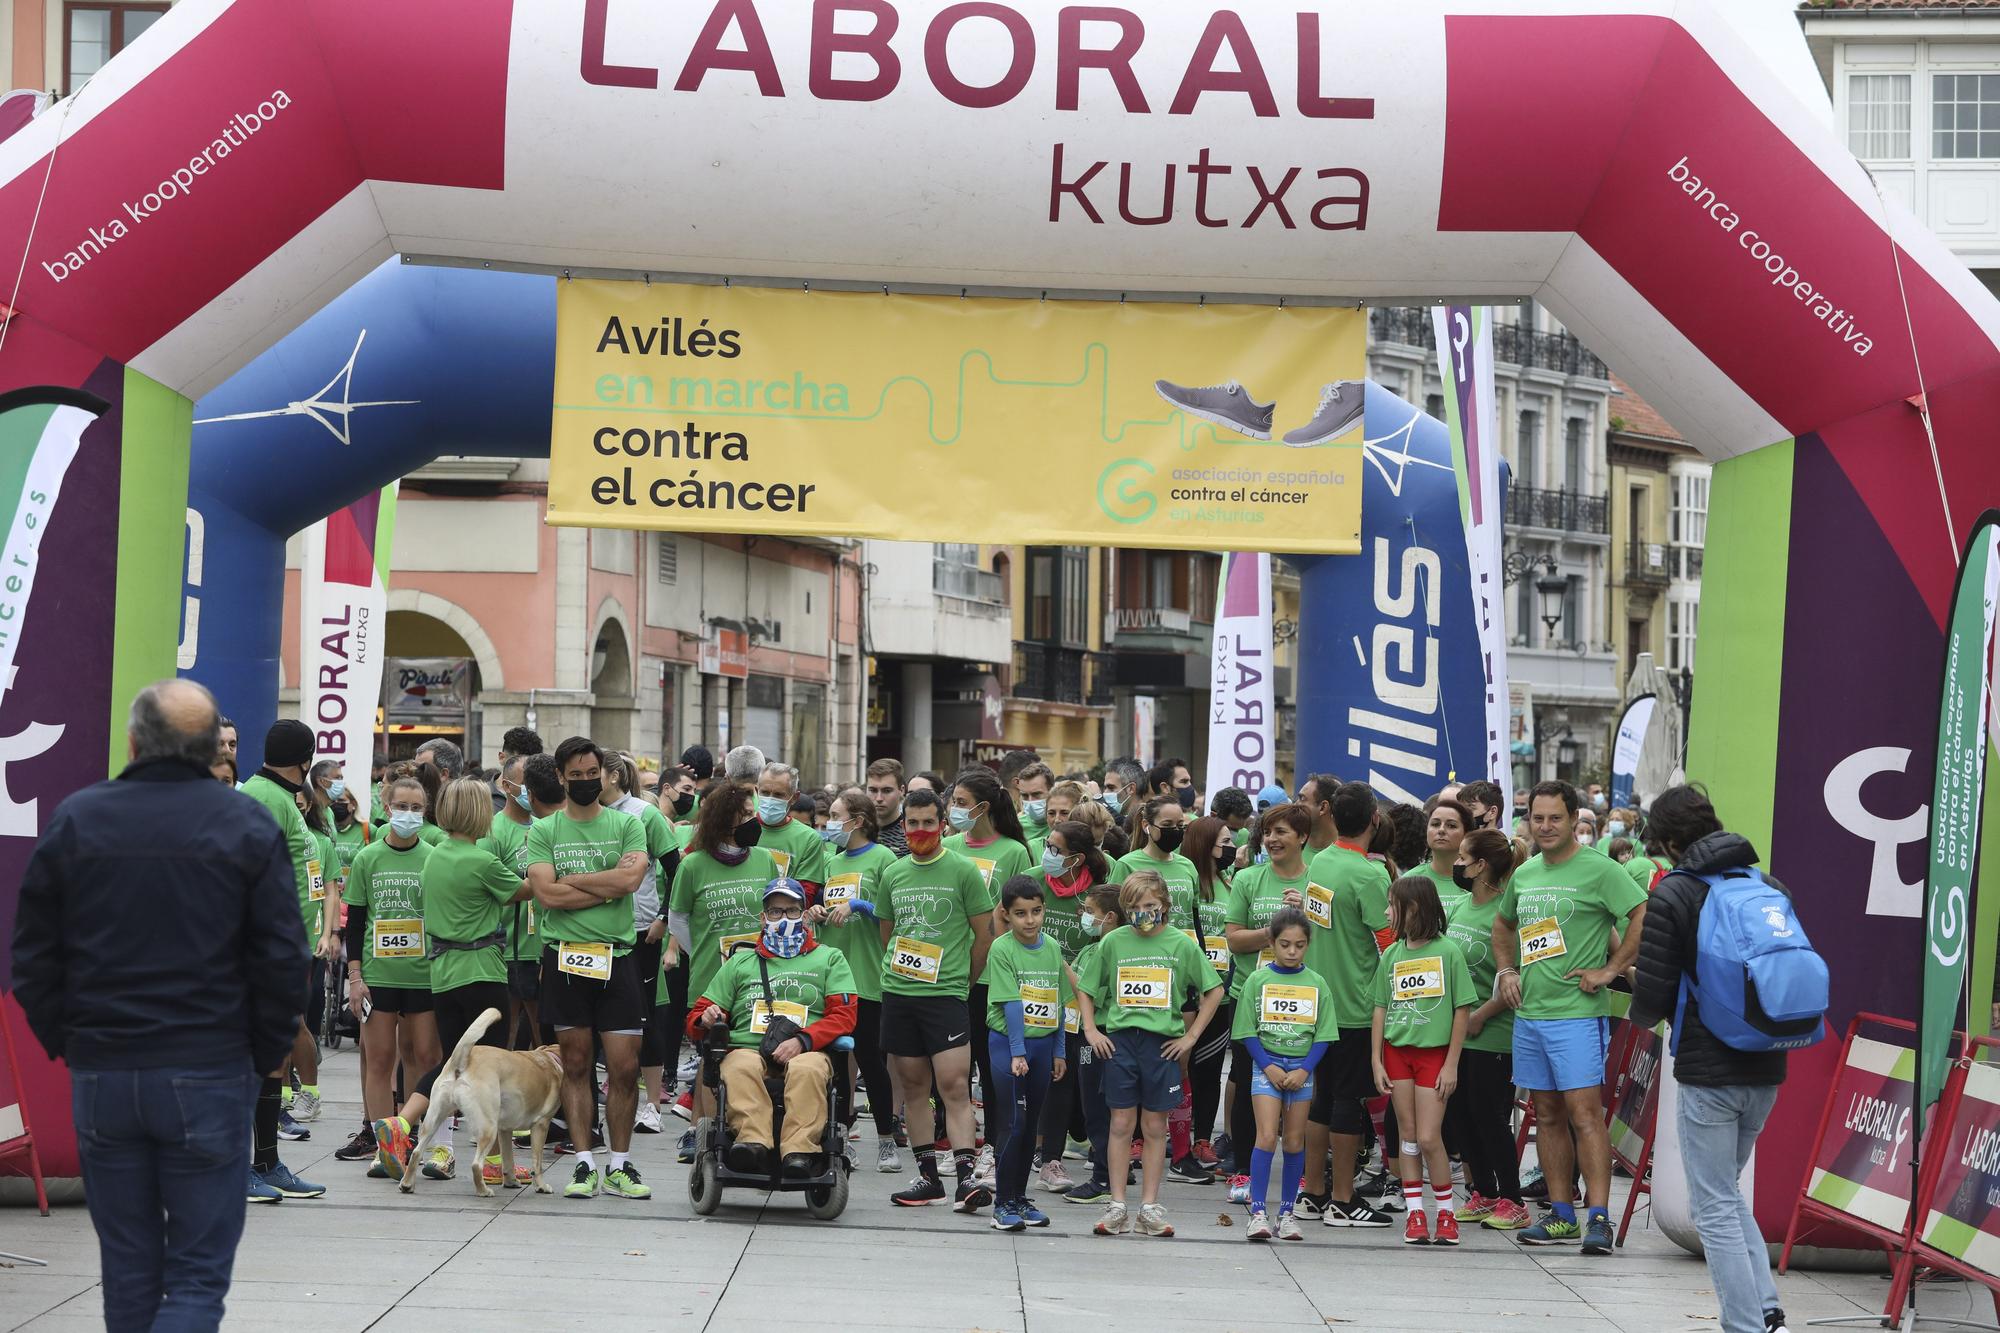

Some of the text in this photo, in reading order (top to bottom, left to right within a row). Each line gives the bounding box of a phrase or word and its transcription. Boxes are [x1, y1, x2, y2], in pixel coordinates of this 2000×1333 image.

[580, 0, 1375, 120] LABORAL
[41, 88, 293, 285] banka kooperatiboa
[1047, 142, 1371, 232] kutxa
[1666, 155, 1876, 357] banca cooperativa
[596, 315, 741, 359] Avilés
[594, 371, 850, 413] en marcha
[592, 422, 749, 461] contra
[1171, 466, 1345, 487] asociación española
[591, 467, 816, 513] el cáncer
[1170, 487, 1309, 504] contra el cáncer
[1169, 507, 1265, 523] en Asturias
[355, 607, 370, 665] kutxa
[316, 604, 351, 767] BORAL
[1947, 684, 1965, 868] contra el cáncer
[553, 848, 602, 860] En marcha
[1959, 843, 1969, 872] en
[555, 860, 586, 871] contra
[372, 877, 419, 889] En marcha
[1167, 884, 1187, 892] archa
[373, 888, 401, 899] contra
[705, 884, 753, 899] En marcha
[827, 888, 845, 898] 472
[901, 892, 935, 903] marcha
[1528, 892, 1557, 902] marcha
[706, 897, 737, 909] contra
[894, 904, 916, 915] ontra
[1200, 904, 1227, 914] marcha
[1252, 902, 1265, 911] En
[1309, 899, 1322, 914] 333
[717, 907, 748, 918] cáncer
[1199, 913, 1212, 921] ntra
[1252, 911, 1273, 921] cont
[1045, 917, 1080, 929] marcha
[1040, 925, 1059, 936] ntra
[381, 936, 408, 947] 545
[1527, 937, 1548, 952] 192
[566, 954, 594, 968] 622
[898, 953, 922, 968] 396
[770, 976, 799, 987] archa
[1400, 975, 1426, 989] 606
[1124, 983, 1152, 995] 260
[1025, 1003, 1048, 1017] 672
[1272, 1000, 1298, 1012] 195
[1844, 1092, 1898, 1142] LABORAL
